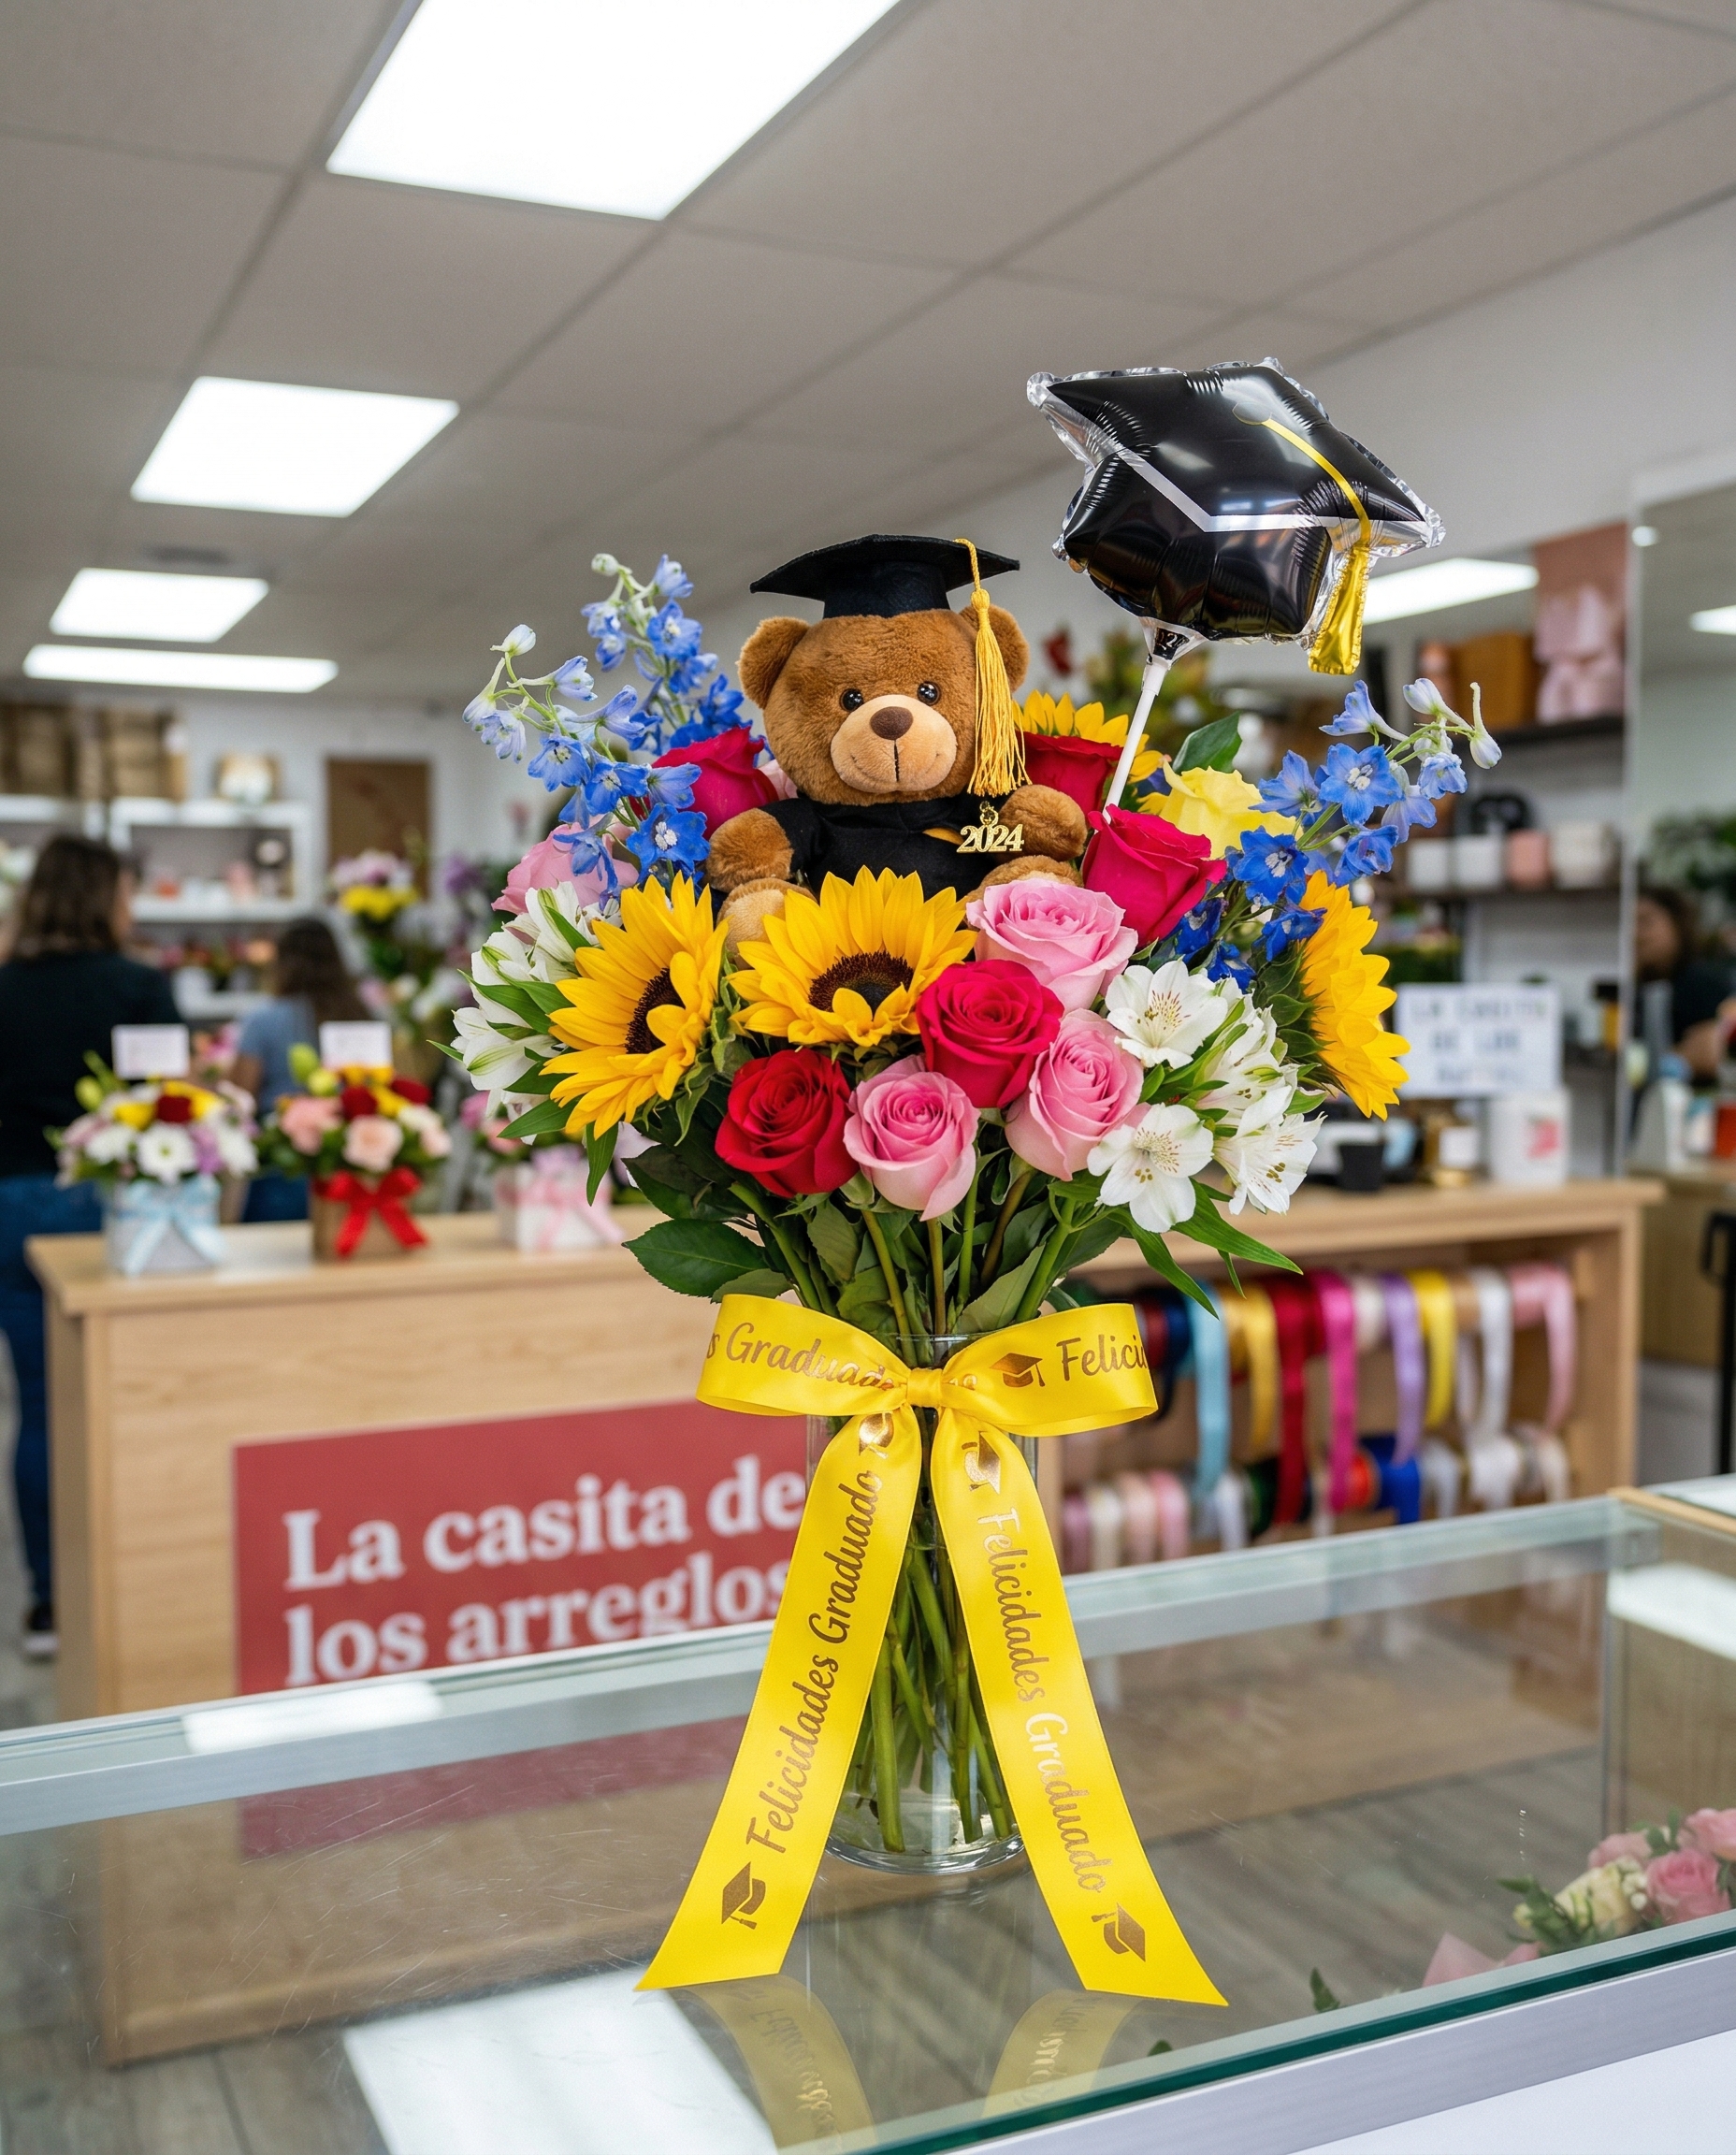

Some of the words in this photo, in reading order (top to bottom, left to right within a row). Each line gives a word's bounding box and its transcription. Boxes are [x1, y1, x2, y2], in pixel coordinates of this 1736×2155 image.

[956, 823, 1025, 853] 2024
[283, 1509, 405, 1591] La
[423, 1473, 692, 1573] casita
[707, 1455, 805, 1537] de
[286, 1604, 429, 1685] los
[745, 1655, 839, 1854] Felicidades
[809, 1470, 883, 1644] Graduado
[976, 1507, 1049, 1702] Felicidades
[1025, 1713, 1112, 1893] Graduado
